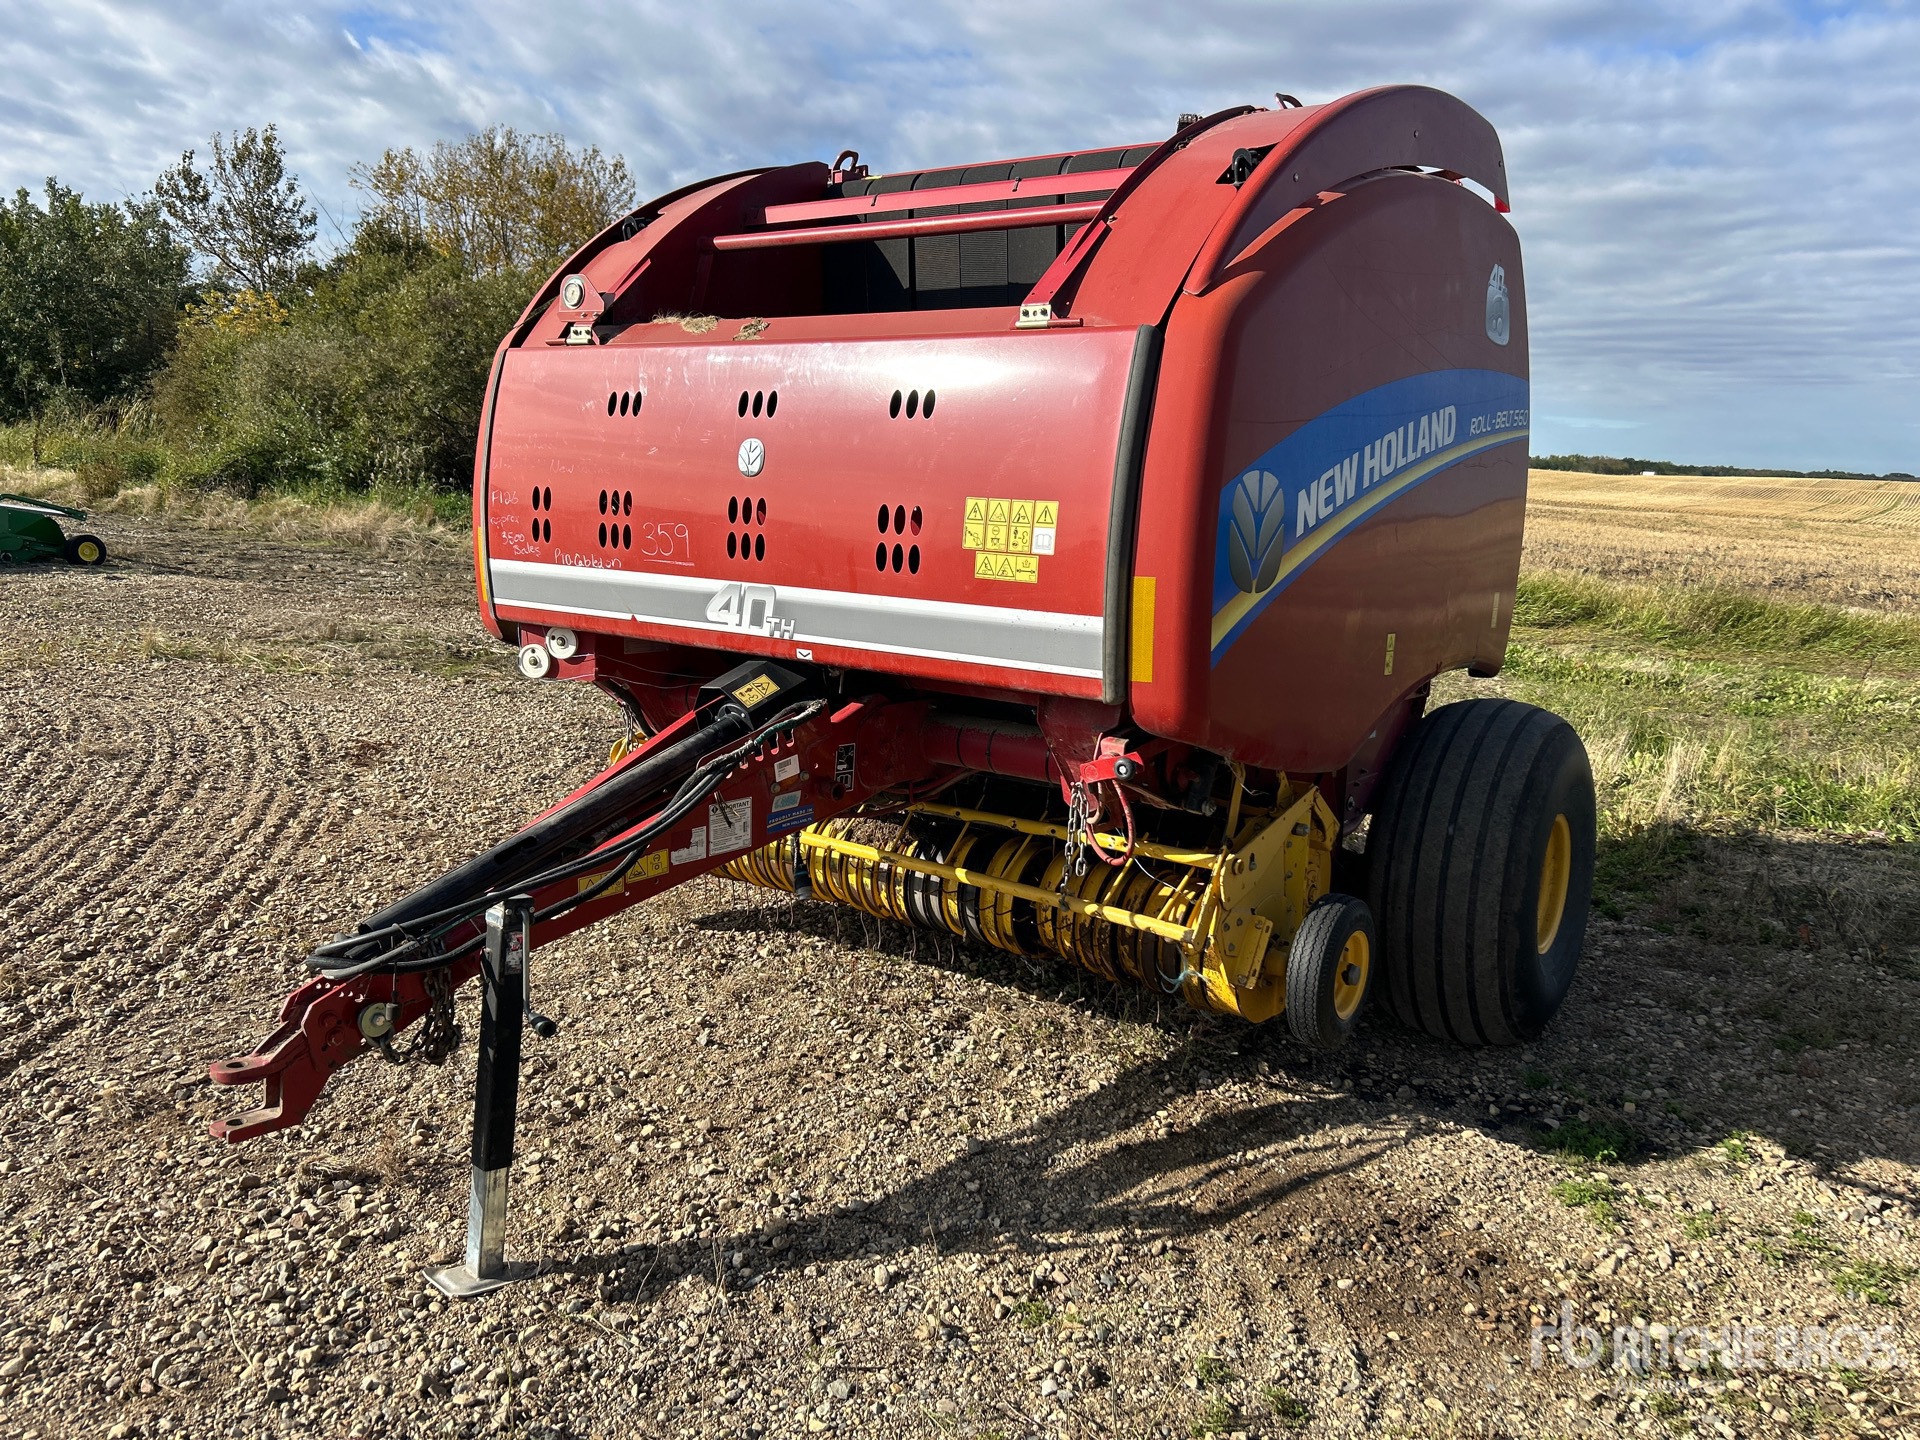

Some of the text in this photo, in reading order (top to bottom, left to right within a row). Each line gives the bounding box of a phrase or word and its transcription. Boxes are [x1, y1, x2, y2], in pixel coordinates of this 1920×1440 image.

[1296, 404, 1457, 538] NEW HOLLAND
[641, 522, 690, 559] 359
